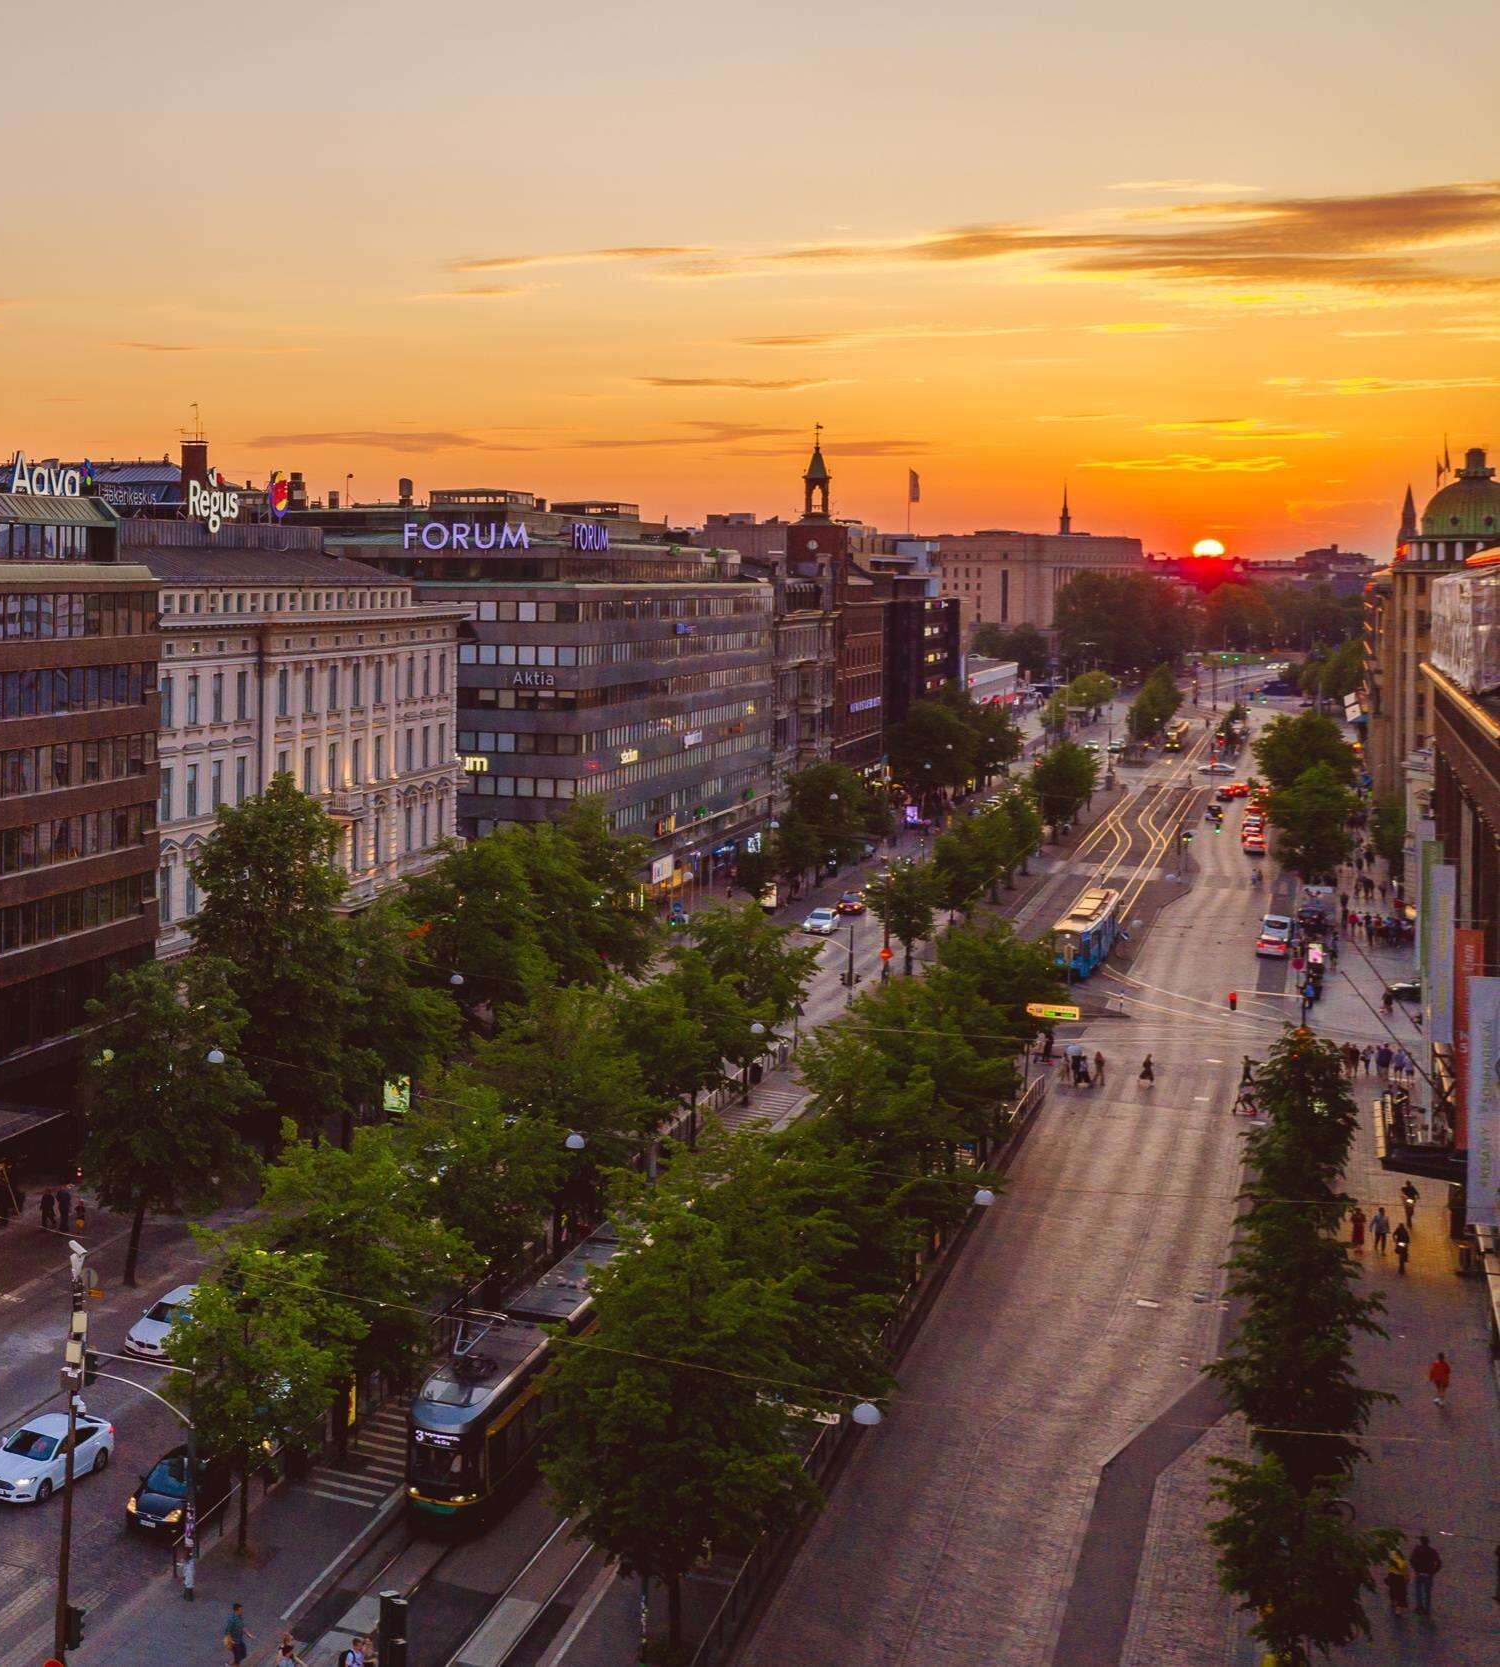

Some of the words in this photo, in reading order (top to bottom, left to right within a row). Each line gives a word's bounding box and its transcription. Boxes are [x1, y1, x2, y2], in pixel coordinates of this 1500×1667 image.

[12, 450, 80, 497] Aava
[189, 480, 239, 533] Regus
[403, 522, 529, 550] FORUM
[574, 523, 609, 551] FORUM
[513, 671, 555, 686] Aktia
[415, 1430, 424, 1441] 3
